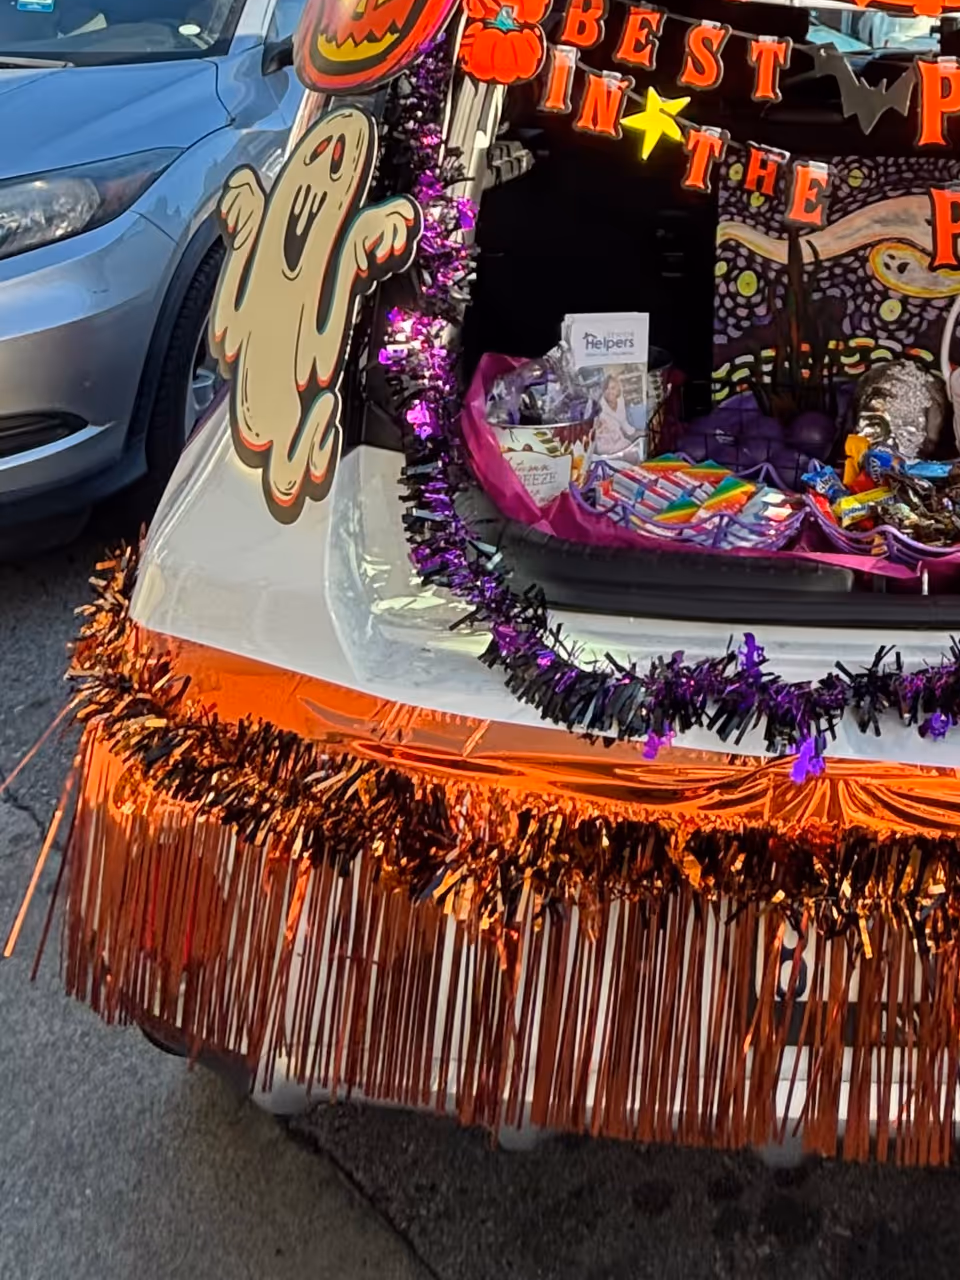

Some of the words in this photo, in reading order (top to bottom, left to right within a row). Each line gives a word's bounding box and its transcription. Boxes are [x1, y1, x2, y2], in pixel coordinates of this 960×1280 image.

[544, 47, 630, 135] IN
[683, 128, 830, 225] THE
[585, 336, 635, 352] Helpers
